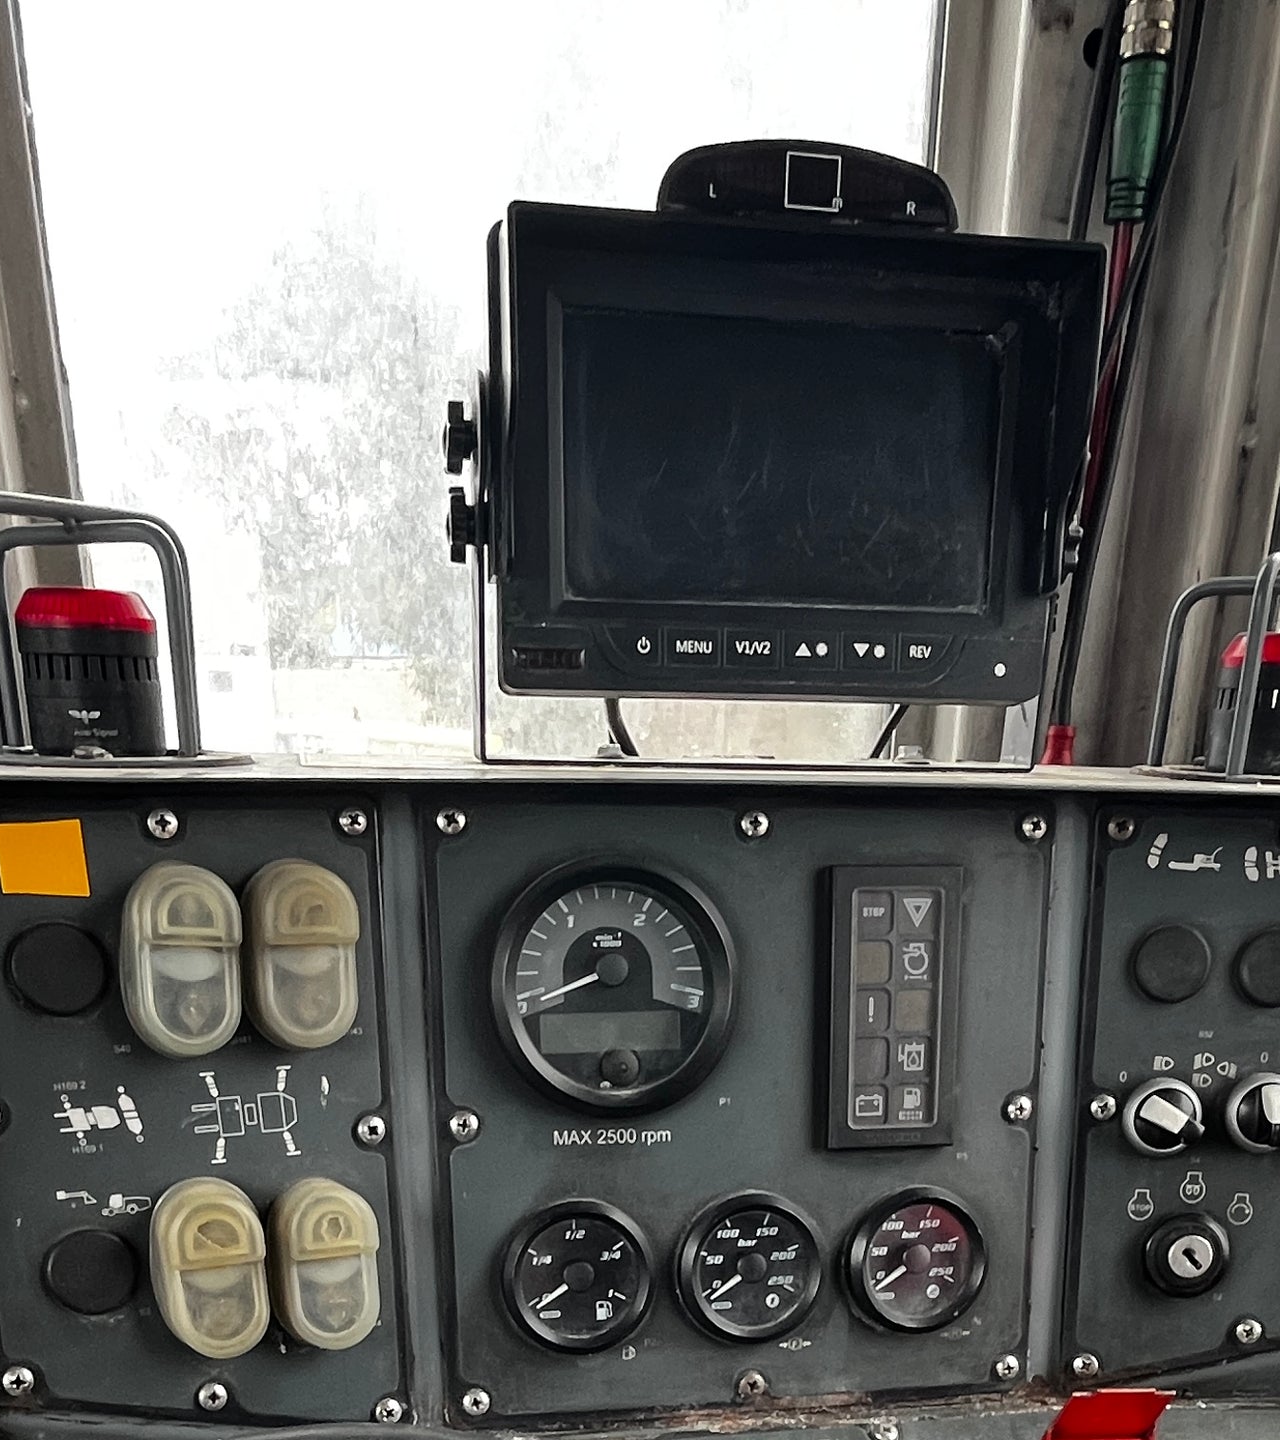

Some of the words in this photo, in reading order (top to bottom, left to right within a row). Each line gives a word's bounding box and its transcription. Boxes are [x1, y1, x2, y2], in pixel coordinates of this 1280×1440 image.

[709, 183, 717, 198] L
[906, 201, 916, 216] R
[675, 640, 713, 654] MENU
[735, 641, 771, 655] V1/V2
[909, 645, 932, 659] REV
[566, 915, 575, 928] 1
[633, 914, 646, 926] 2
[687, 996, 700, 1009] 3
[1260, 1052, 1269, 1063] 0
[1119, 1071, 1128, 1083] 0
[552, 1131, 593, 1146] MAX
[596, 1129, 637, 1144] 2500
[641, 1129, 671, 1146] rpm
[1130, 1203, 1151, 1212] STOP
[881, 1221, 904, 1231] 100
[919, 1219, 941, 1229] 150
[565, 1229, 585, 1240] 1/2
[716, 1229, 740, 1239] 100
[755, 1226, 779, 1237] 150
[901, 1230, 921, 1239] bar
[737, 1238, 758, 1247] bar
[932, 1242, 957, 1252] 200
[599, 1250, 621, 1261] 3/4
[770, 1250, 796, 1261] 200
[871, 1246, 888, 1256] 50
[531, 1254, 552, 1266] 1/4
[705, 1255, 724, 1265] 50
[876, 1270, 886, 1280] 0
[928, 1266, 954, 1276] 250
[712, 1280, 721, 1289] 0
[767, 1275, 794, 1285] 250
[607, 1289, 614, 1298] 1
